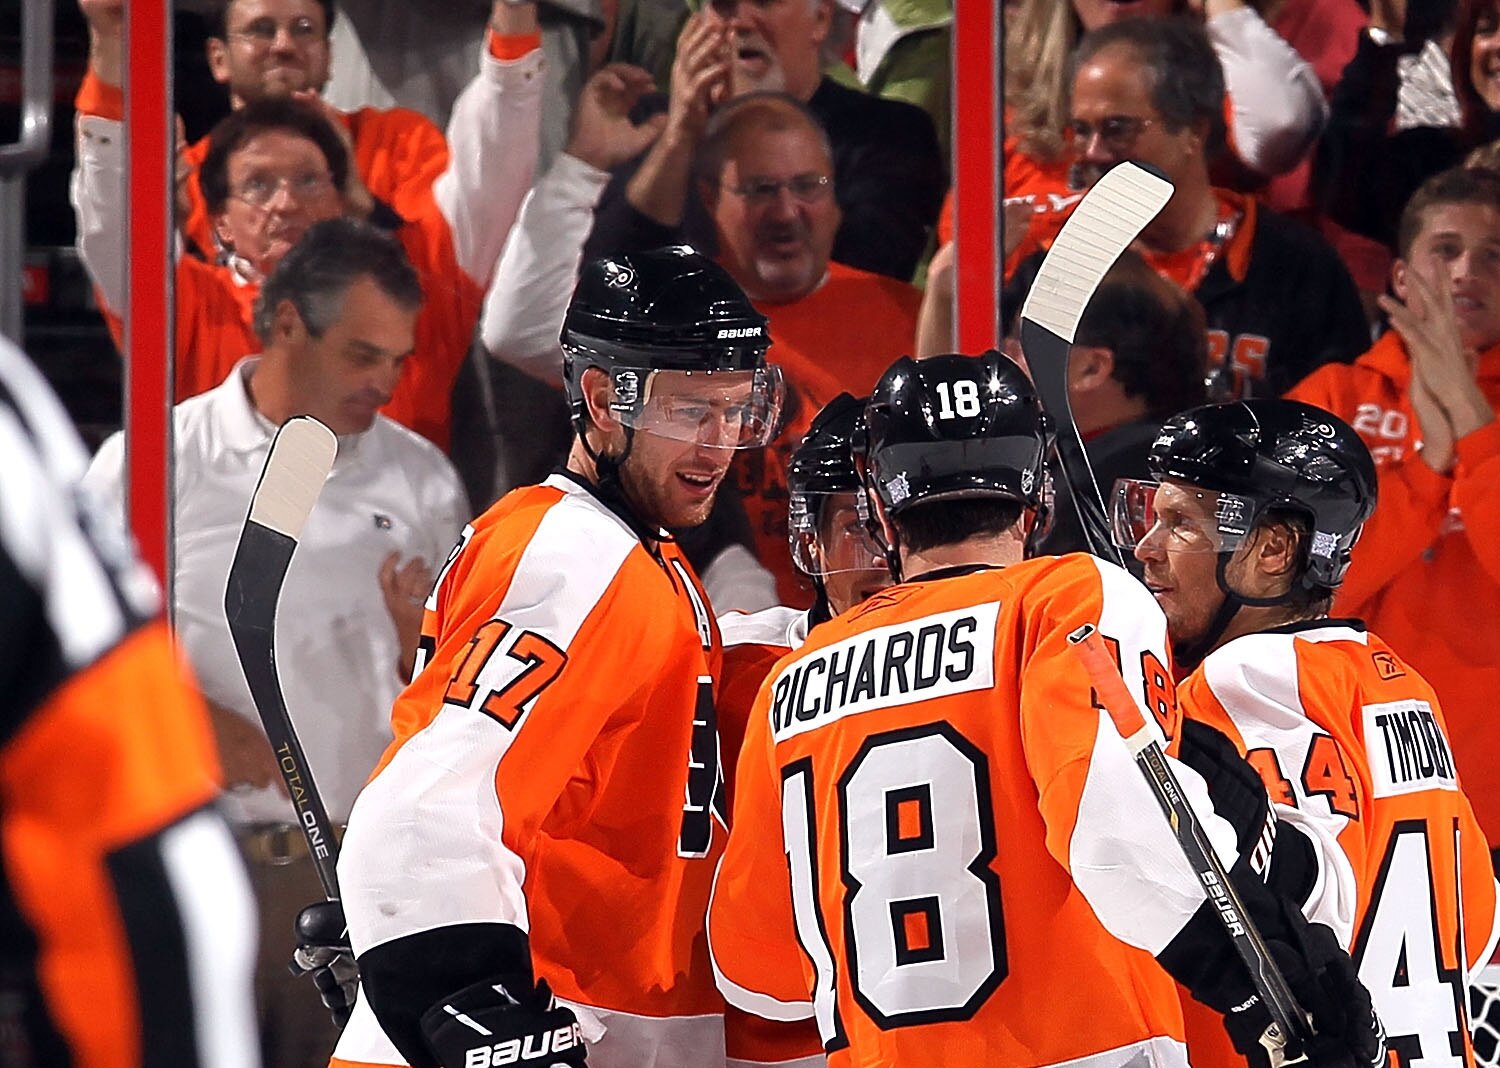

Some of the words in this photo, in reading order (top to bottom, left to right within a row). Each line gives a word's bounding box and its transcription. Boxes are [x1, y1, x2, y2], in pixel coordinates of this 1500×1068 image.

[936, 380, 981, 419] 18
[442, 618, 569, 732] 17
[772, 615, 978, 735] RICHARDS
[779, 719, 1010, 1057] 18
